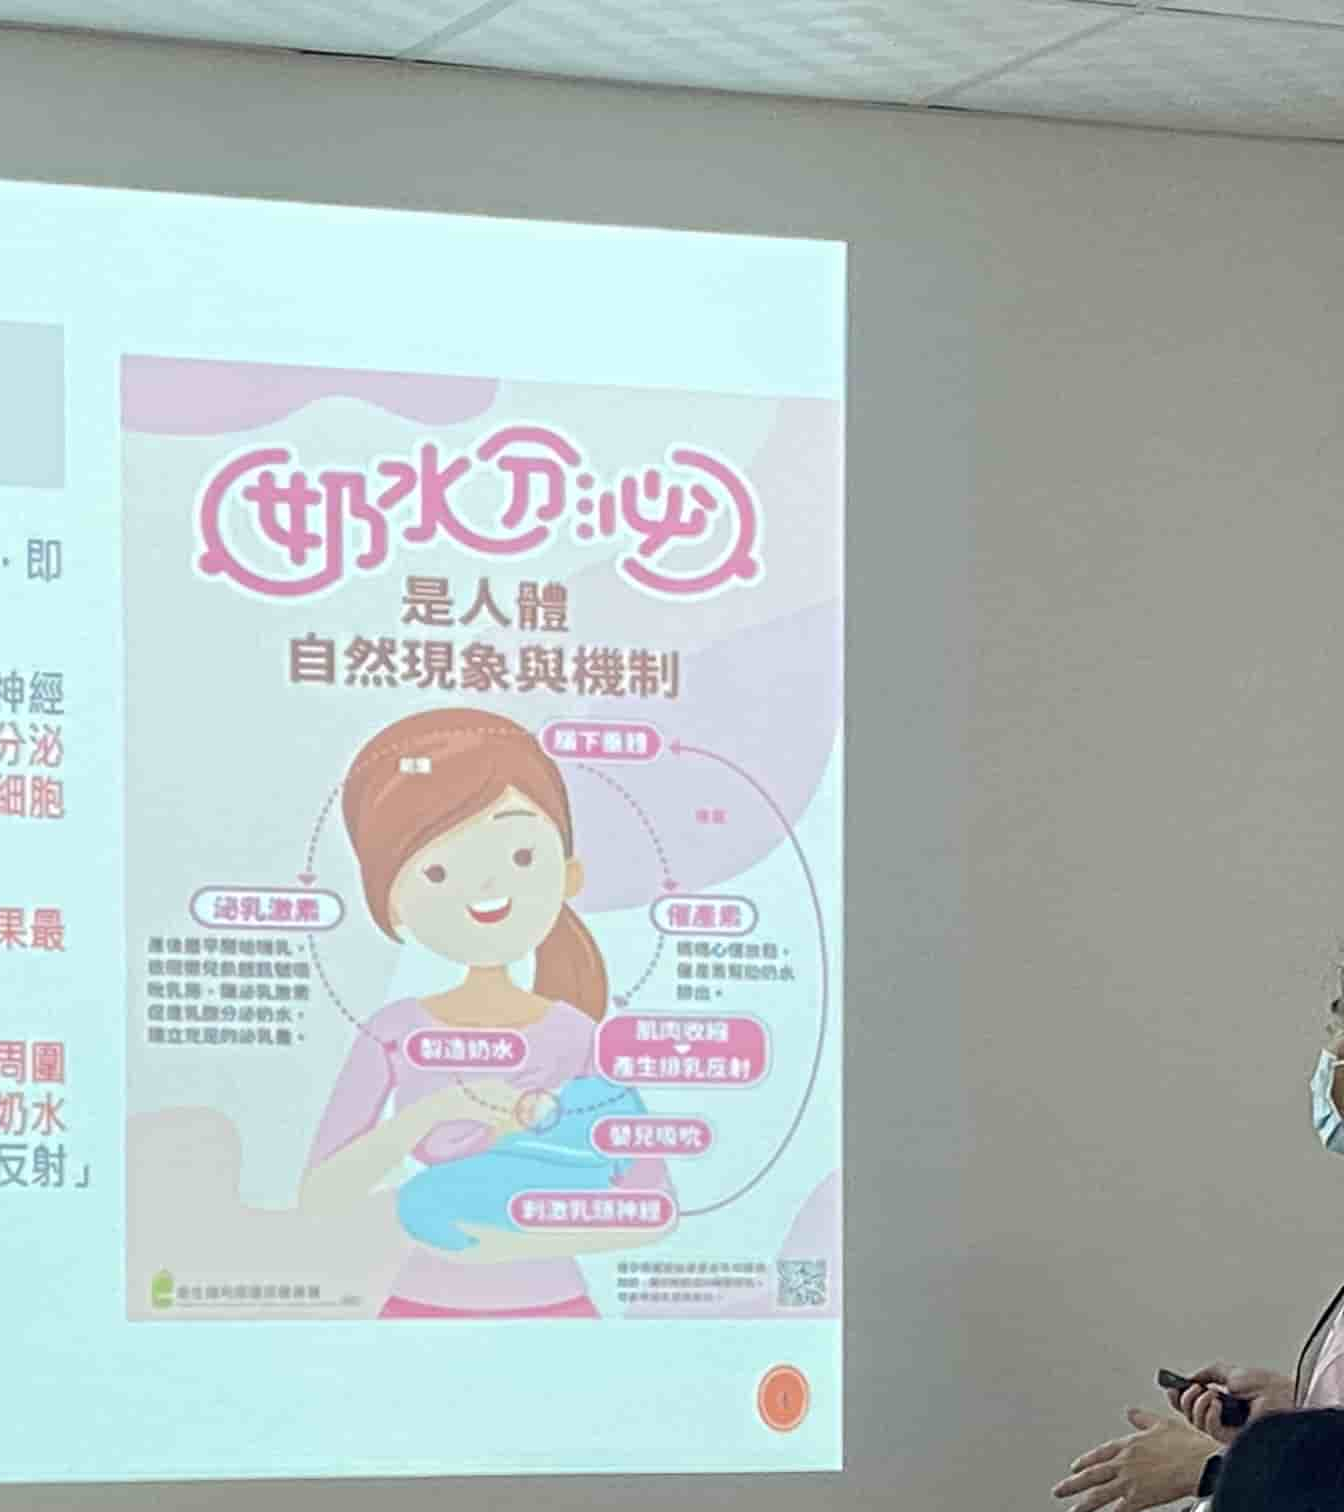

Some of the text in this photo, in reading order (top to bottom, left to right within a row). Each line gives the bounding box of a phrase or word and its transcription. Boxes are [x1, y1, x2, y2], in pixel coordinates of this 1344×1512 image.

[199, 425, 759, 597] 奶水分泌
[402, 576, 569, 631] 是人體
[289, 636, 679, 699] 自然現象與機制
